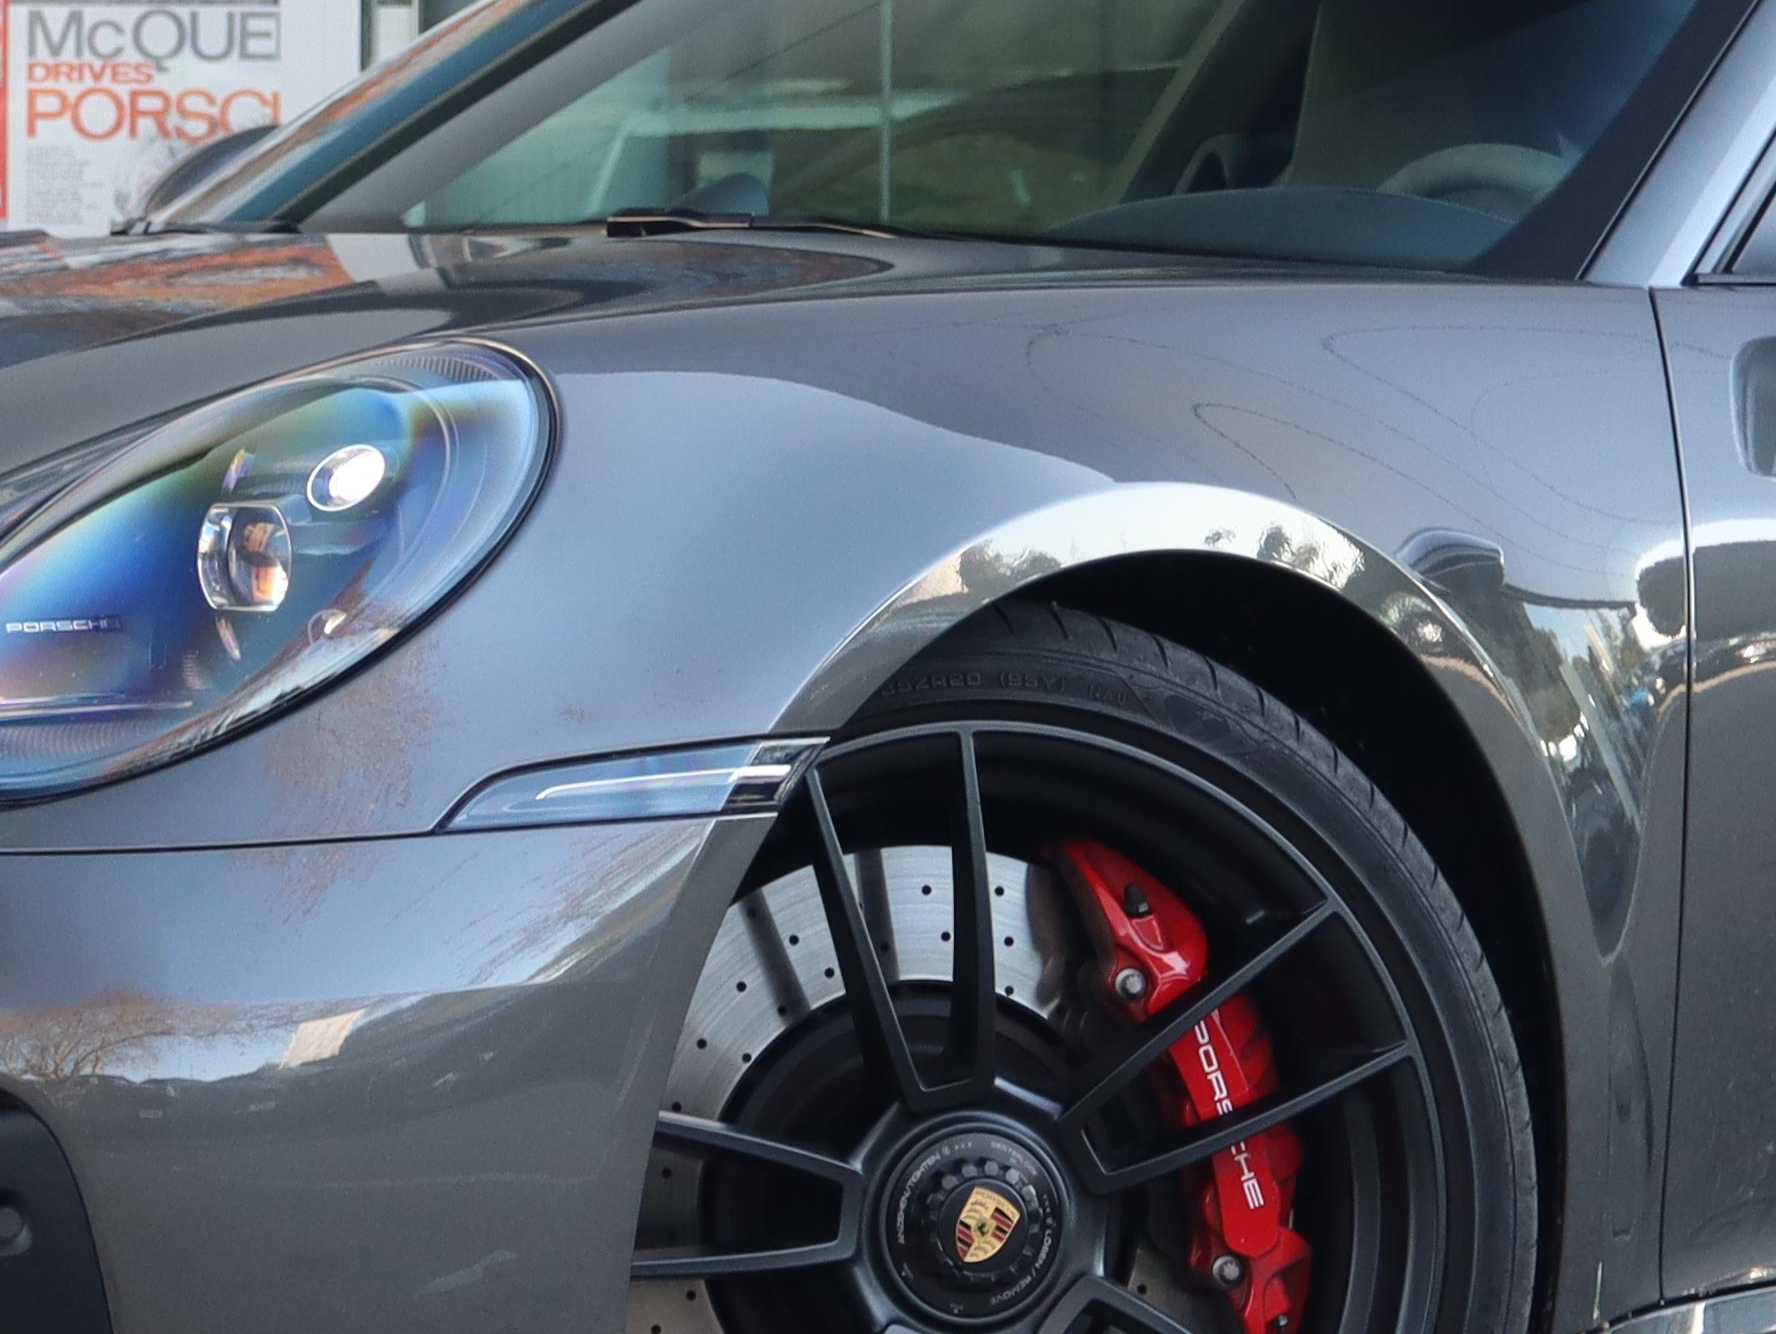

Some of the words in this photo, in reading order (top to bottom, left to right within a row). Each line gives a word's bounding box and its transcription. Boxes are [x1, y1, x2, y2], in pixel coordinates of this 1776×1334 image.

[27, 9, 281, 71] McQUE
[27, 62, 155, 83] DRIVES
[26, 88, 282, 143] PORSC
